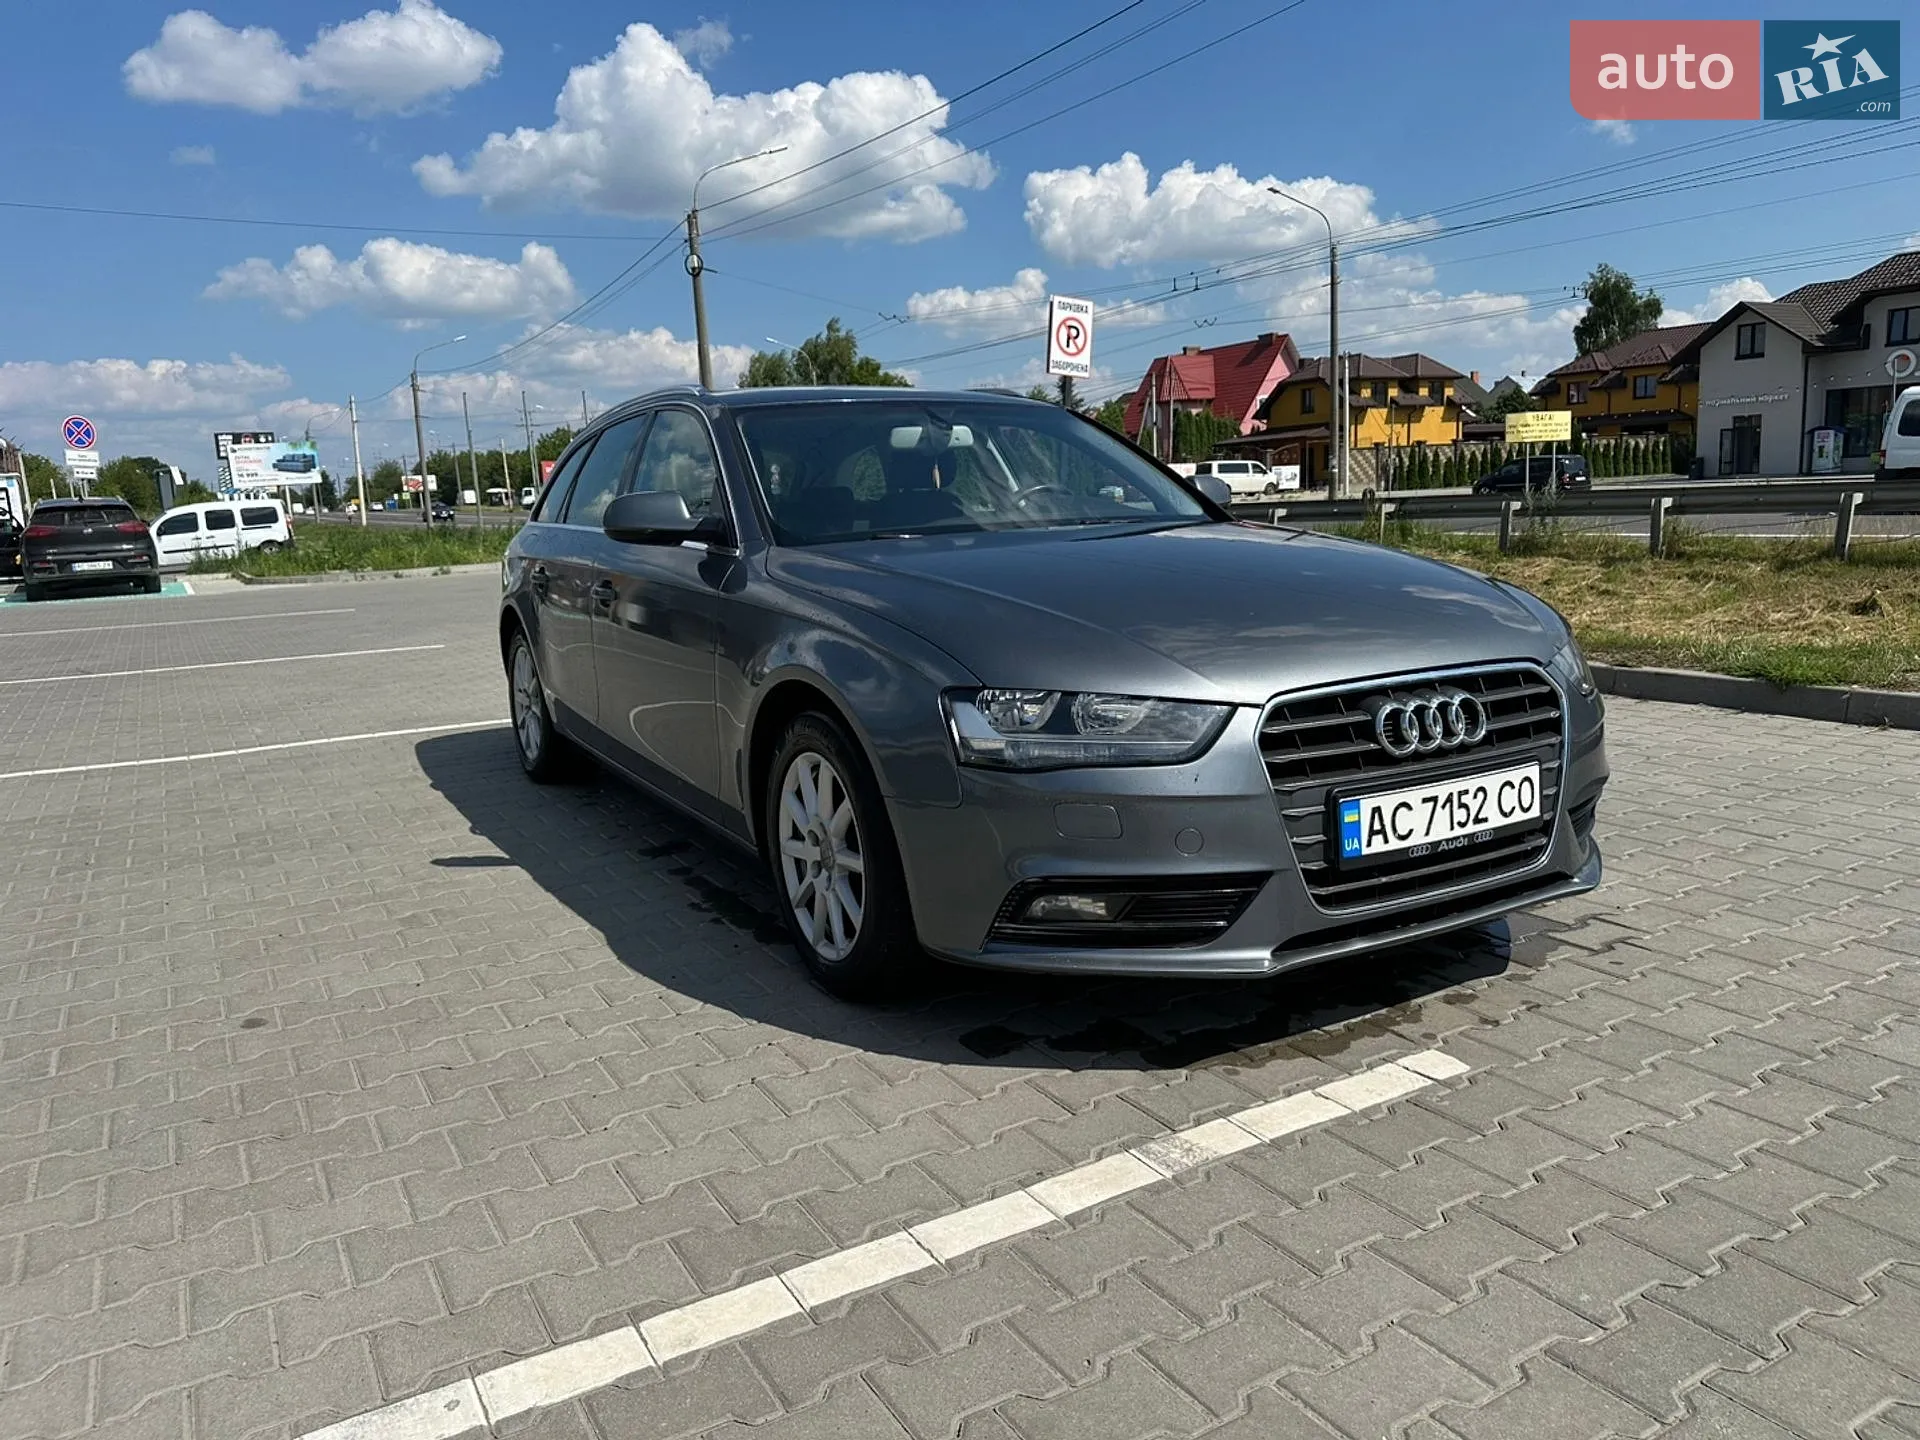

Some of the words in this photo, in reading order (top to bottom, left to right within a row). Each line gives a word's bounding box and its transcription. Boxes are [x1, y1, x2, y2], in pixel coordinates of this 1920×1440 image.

[1057, 300, 1088, 313] ПАРКОВКА
[1051, 359, 1088, 373] ЗАБОРОНЕНА
[1366, 801, 1413, 848] AC
[1421, 786, 1489, 837] 7152
[1497, 776, 1535, 818] CO
[1344, 837, 1360, 851] UA
